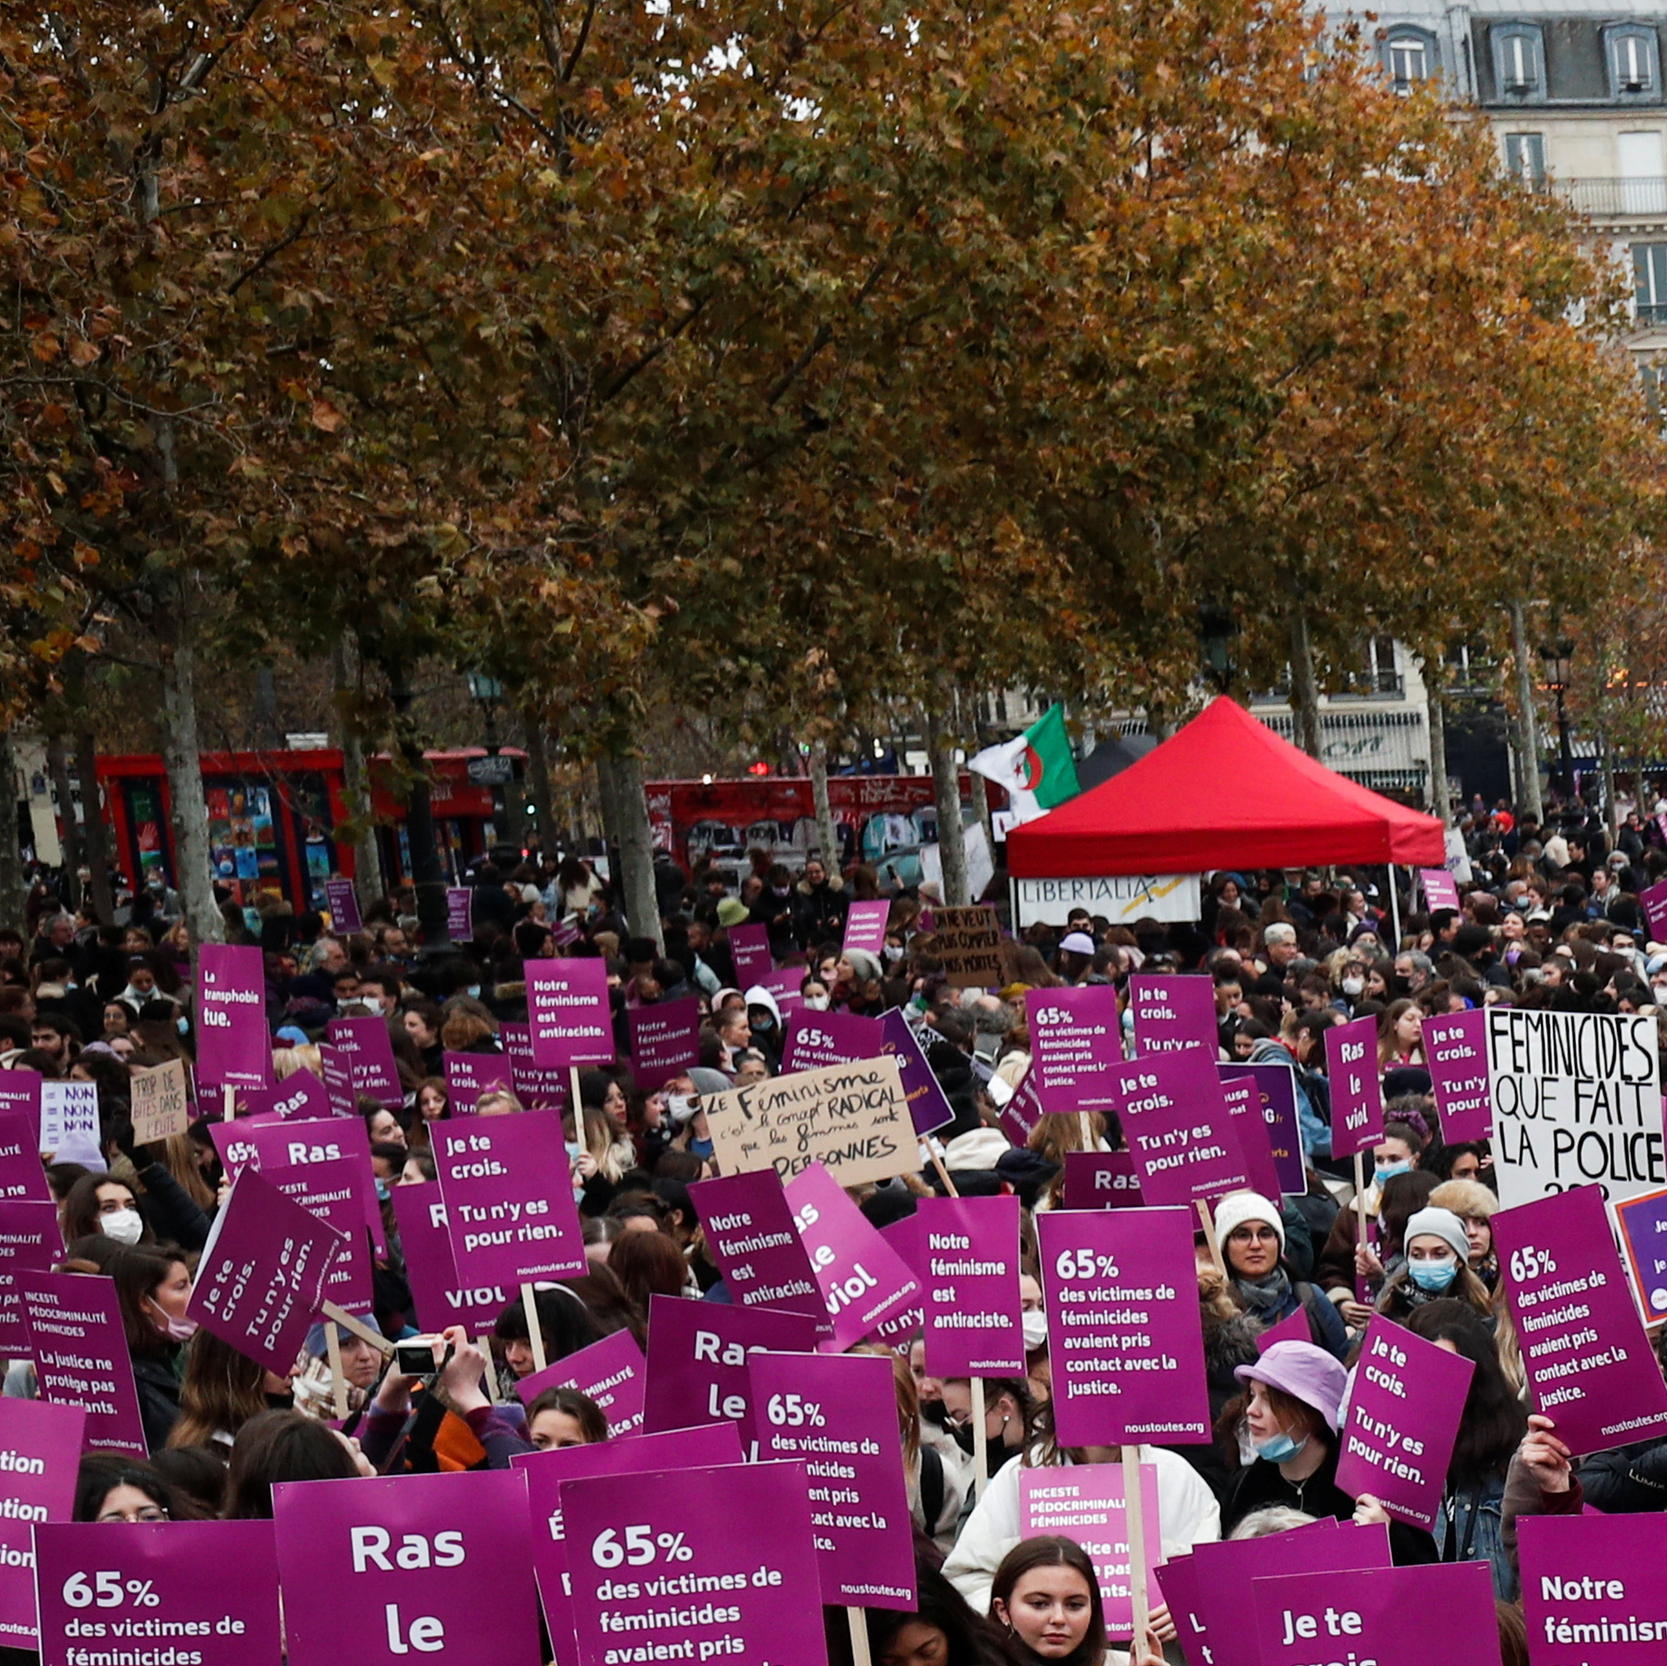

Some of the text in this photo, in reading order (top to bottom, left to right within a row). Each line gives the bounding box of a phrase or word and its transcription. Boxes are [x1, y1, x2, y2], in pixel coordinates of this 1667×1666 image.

[1490, 1011, 1653, 1081] FEMINICIDES
[63, 1104, 94, 1117] NON
[65, 1087, 93, 1100] NON
[707, 1072, 885, 1120] LE Féminisme
[1496, 1075, 1652, 1126] QUE FAIT
[64, 1121, 93, 1131] NON
[720, 1124, 747, 1139] c'est
[777, 1103, 825, 1128] concept
[741, 1142, 760, 1160] que
[769, 1131, 787, 1147] les
[798, 1123, 858, 1152] femmes
[1499, 1121, 1665, 1183] LA POLICE
[1655, 1221, 1667, 1233] Je
[351, 1526, 465, 1572] Ras
[63, 1571, 160, 1607] 65%
[1541, 1576, 1624, 1600] Notre
[65, 1616, 245, 1637] des victimes de
[386, 1604, 444, 1654] le
[1283, 1608, 1362, 1645] Je te
[66, 1647, 202, 1666] féminicides
